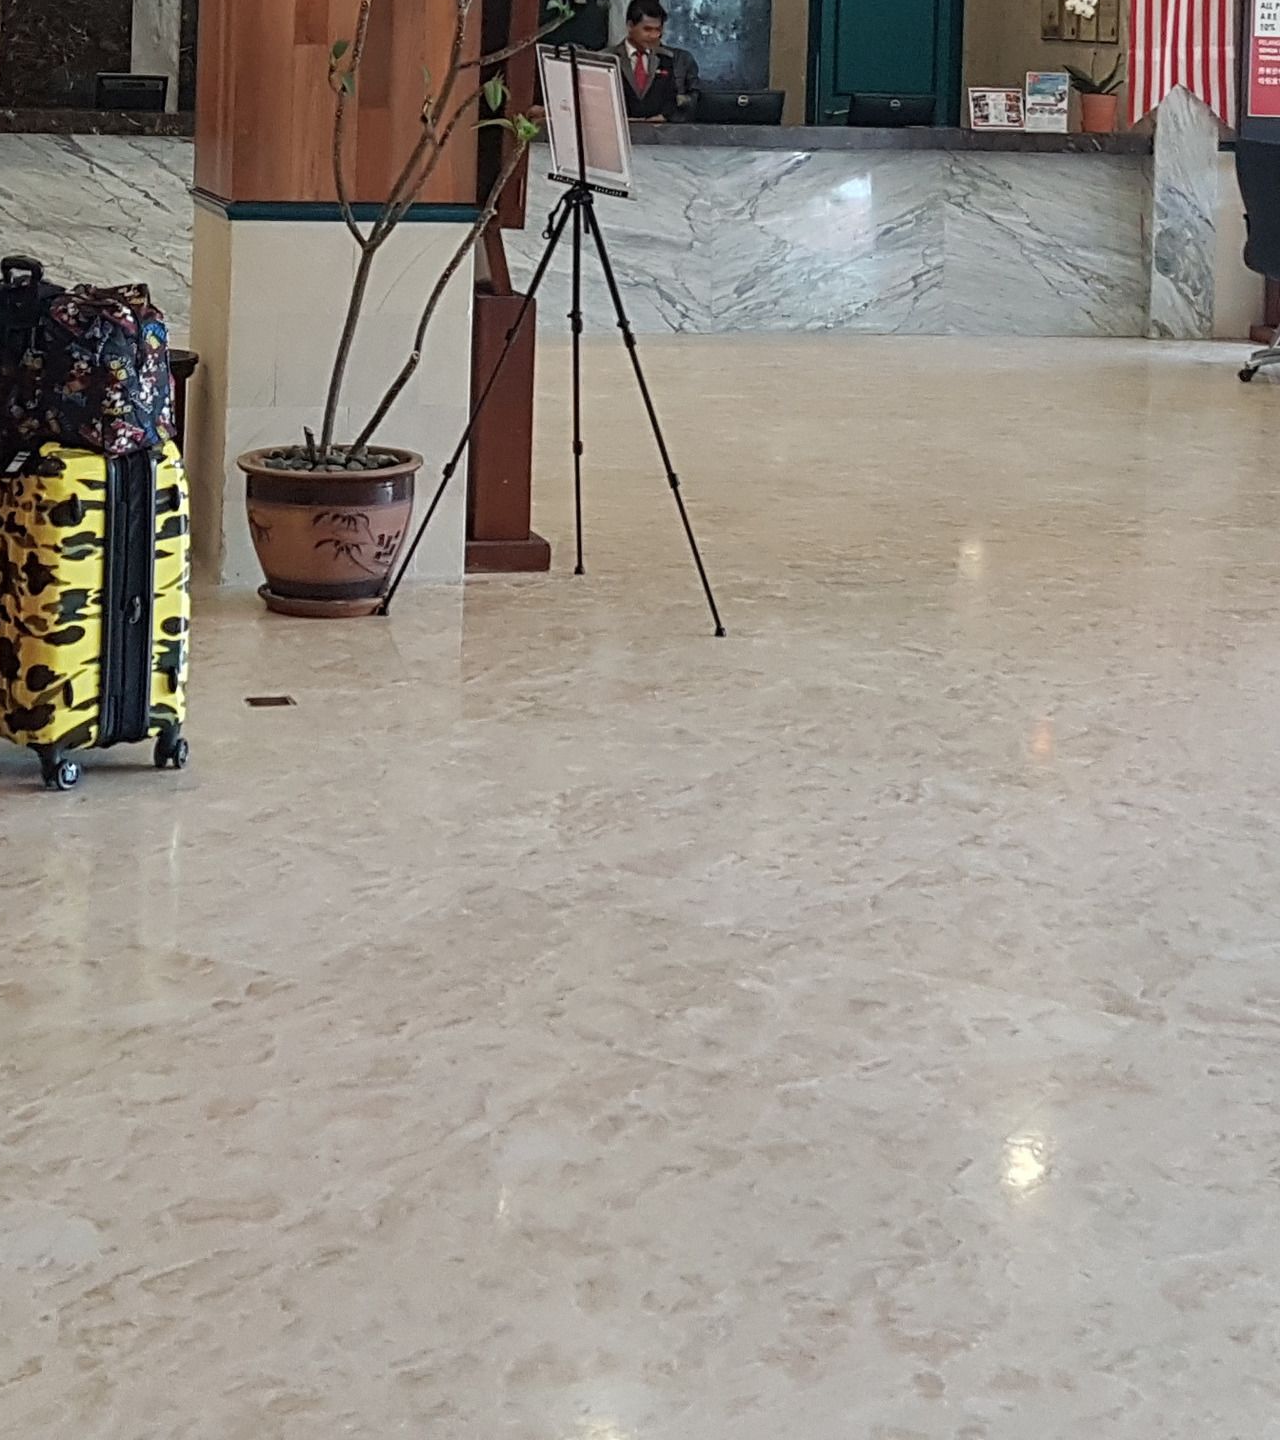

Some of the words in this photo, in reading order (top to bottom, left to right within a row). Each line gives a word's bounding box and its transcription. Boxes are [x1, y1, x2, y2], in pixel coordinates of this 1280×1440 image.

[1260, 2, 1273, 10] ALL
[1260, 13, 1277, 21] ARE
[1260, 23, 1276, 31] 10%
